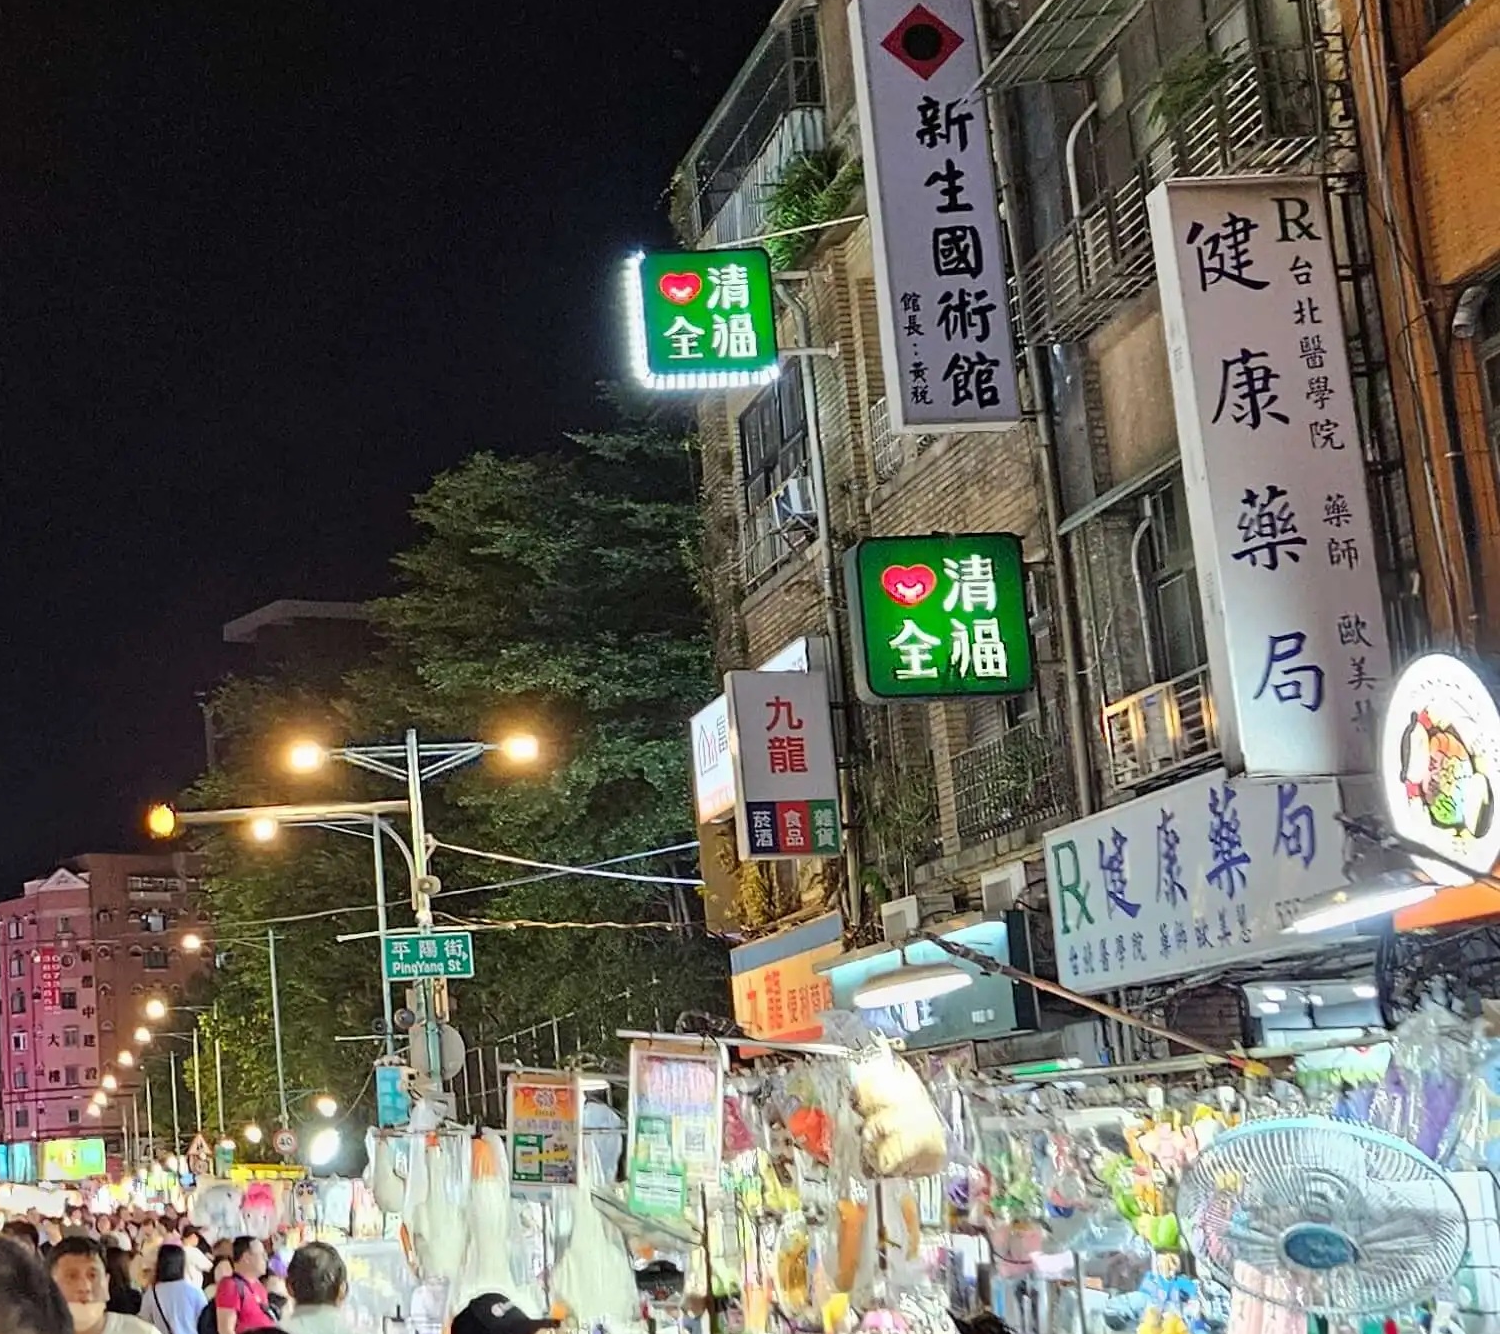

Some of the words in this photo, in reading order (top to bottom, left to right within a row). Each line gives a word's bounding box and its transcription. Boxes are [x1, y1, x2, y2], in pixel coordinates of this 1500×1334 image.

[915, 96, 1001, 409] 新生國術館
[1288, 255, 1346, 451] 台北醫學院
[1322, 493, 1360, 570] 藥師
[1186, 211, 1326, 712] 健康藥局
[765, 695, 809, 774] 九龍
[752, 810, 774, 848] 菸酒
[783, 809, 805, 847] 食品
[813, 808, 836, 848] 雜貨
[1097, 781, 1316, 920] 健康藥局
[390, 938, 465, 961] 平陽街
[392, 960, 445, 978] PingYang
[278, 1136, 293, 1147] 40
